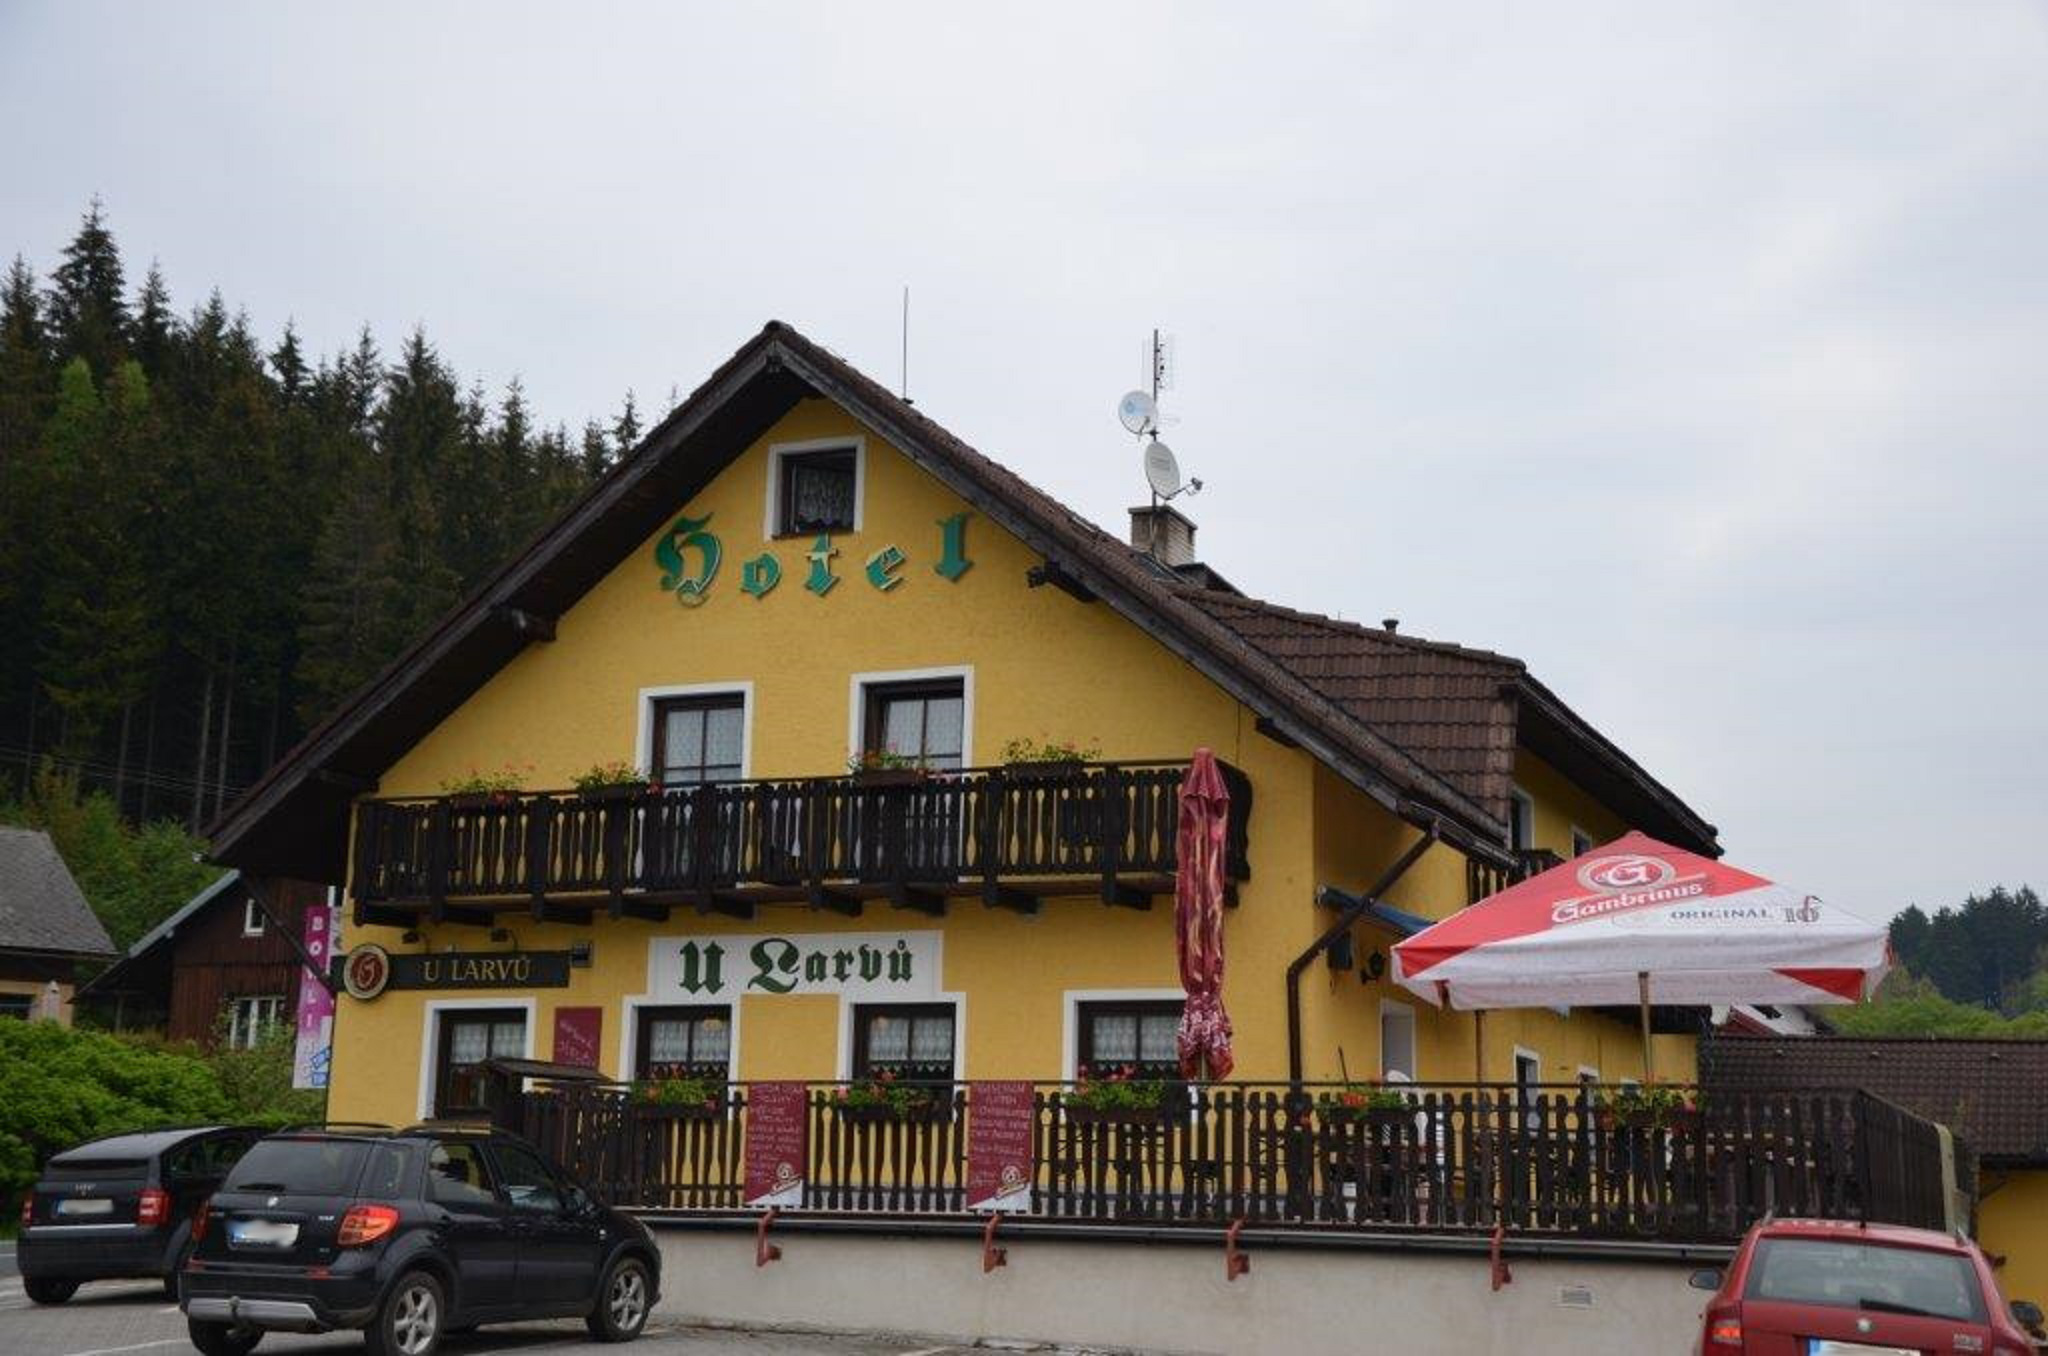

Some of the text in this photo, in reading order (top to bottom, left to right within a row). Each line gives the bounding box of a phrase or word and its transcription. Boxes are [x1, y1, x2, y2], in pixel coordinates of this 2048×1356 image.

[656, 511, 976, 607] Hotel
[1552, 882, 1704, 923] Gambrinus
[1671, 908, 1774, 920] ORIGINAL
[423, 960, 440, 981] U
[679, 937, 913, 995] U Larvů
